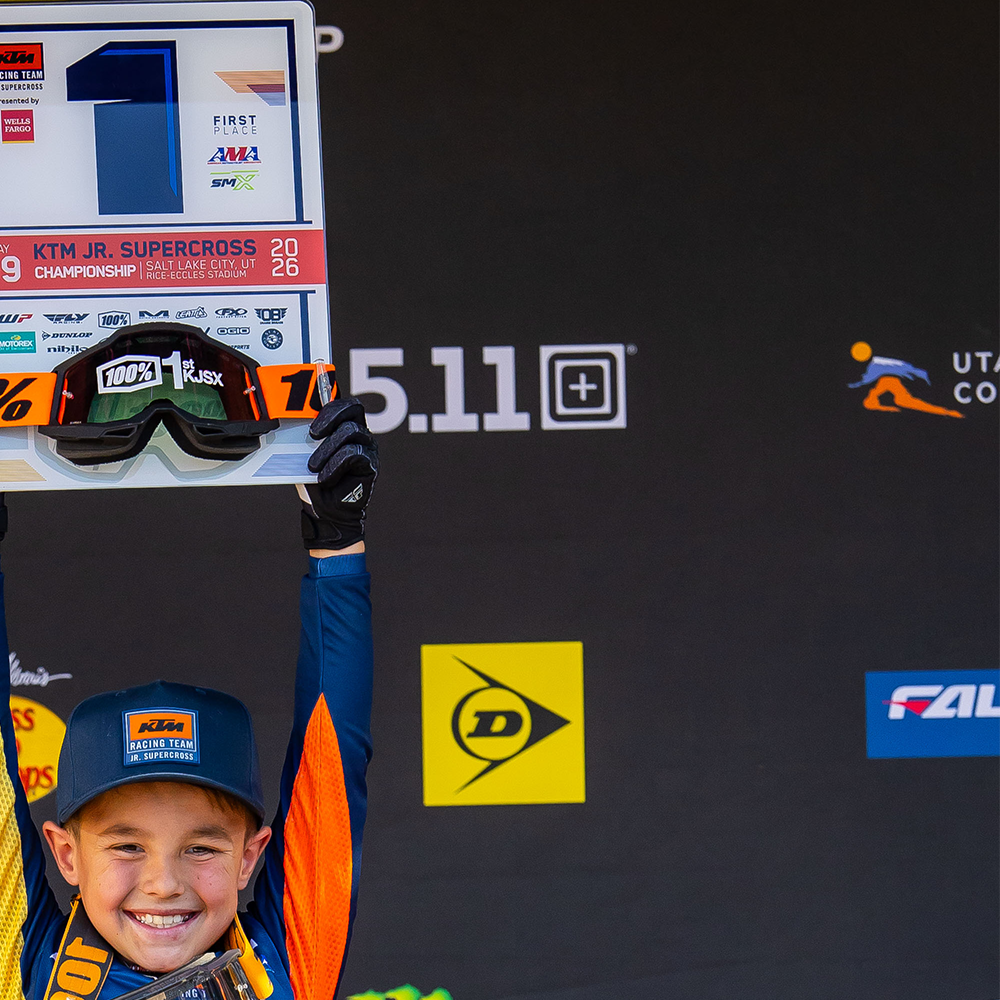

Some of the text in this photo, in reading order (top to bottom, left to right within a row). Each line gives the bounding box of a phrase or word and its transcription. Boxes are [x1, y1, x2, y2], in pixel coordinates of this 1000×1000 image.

[21, 70, 43, 79] TEAM
[1, 83, 44, 91] SUPERCROSS
[31, 97, 40, 105] by
[213, 114, 257, 126] FIRST
[4, 125, 32, 133] FARGO
[66, 40, 185, 215] 1
[213, 126, 257, 135] PLACE
[207, 146, 261, 162] AMA
[210, 174, 256, 191] SMX
[33, 239, 257, 260] KTM JR. SUPERCROSS
[270, 238, 299, 257] 20
[146, 258, 256, 271] SALT LAKE CITY, UT
[271, 258, 300, 277] 26
[34, 264, 137, 279] CHAMPIONSHIP
[146, 270, 247, 280] RICE-ECCLES STADIUM
[101, 314, 128, 327] 100%
[217, 327, 250, 336] OGIO
[105, 361, 154, 387] 100%
[183, 369, 225, 388] KJSX
[349, 345, 531, 435] 5.11
[138, 718, 185, 733] KTM
[130, 739, 194, 751] RACING TEAM
[130, 751, 194, 762] JR. SUPERCROSS
